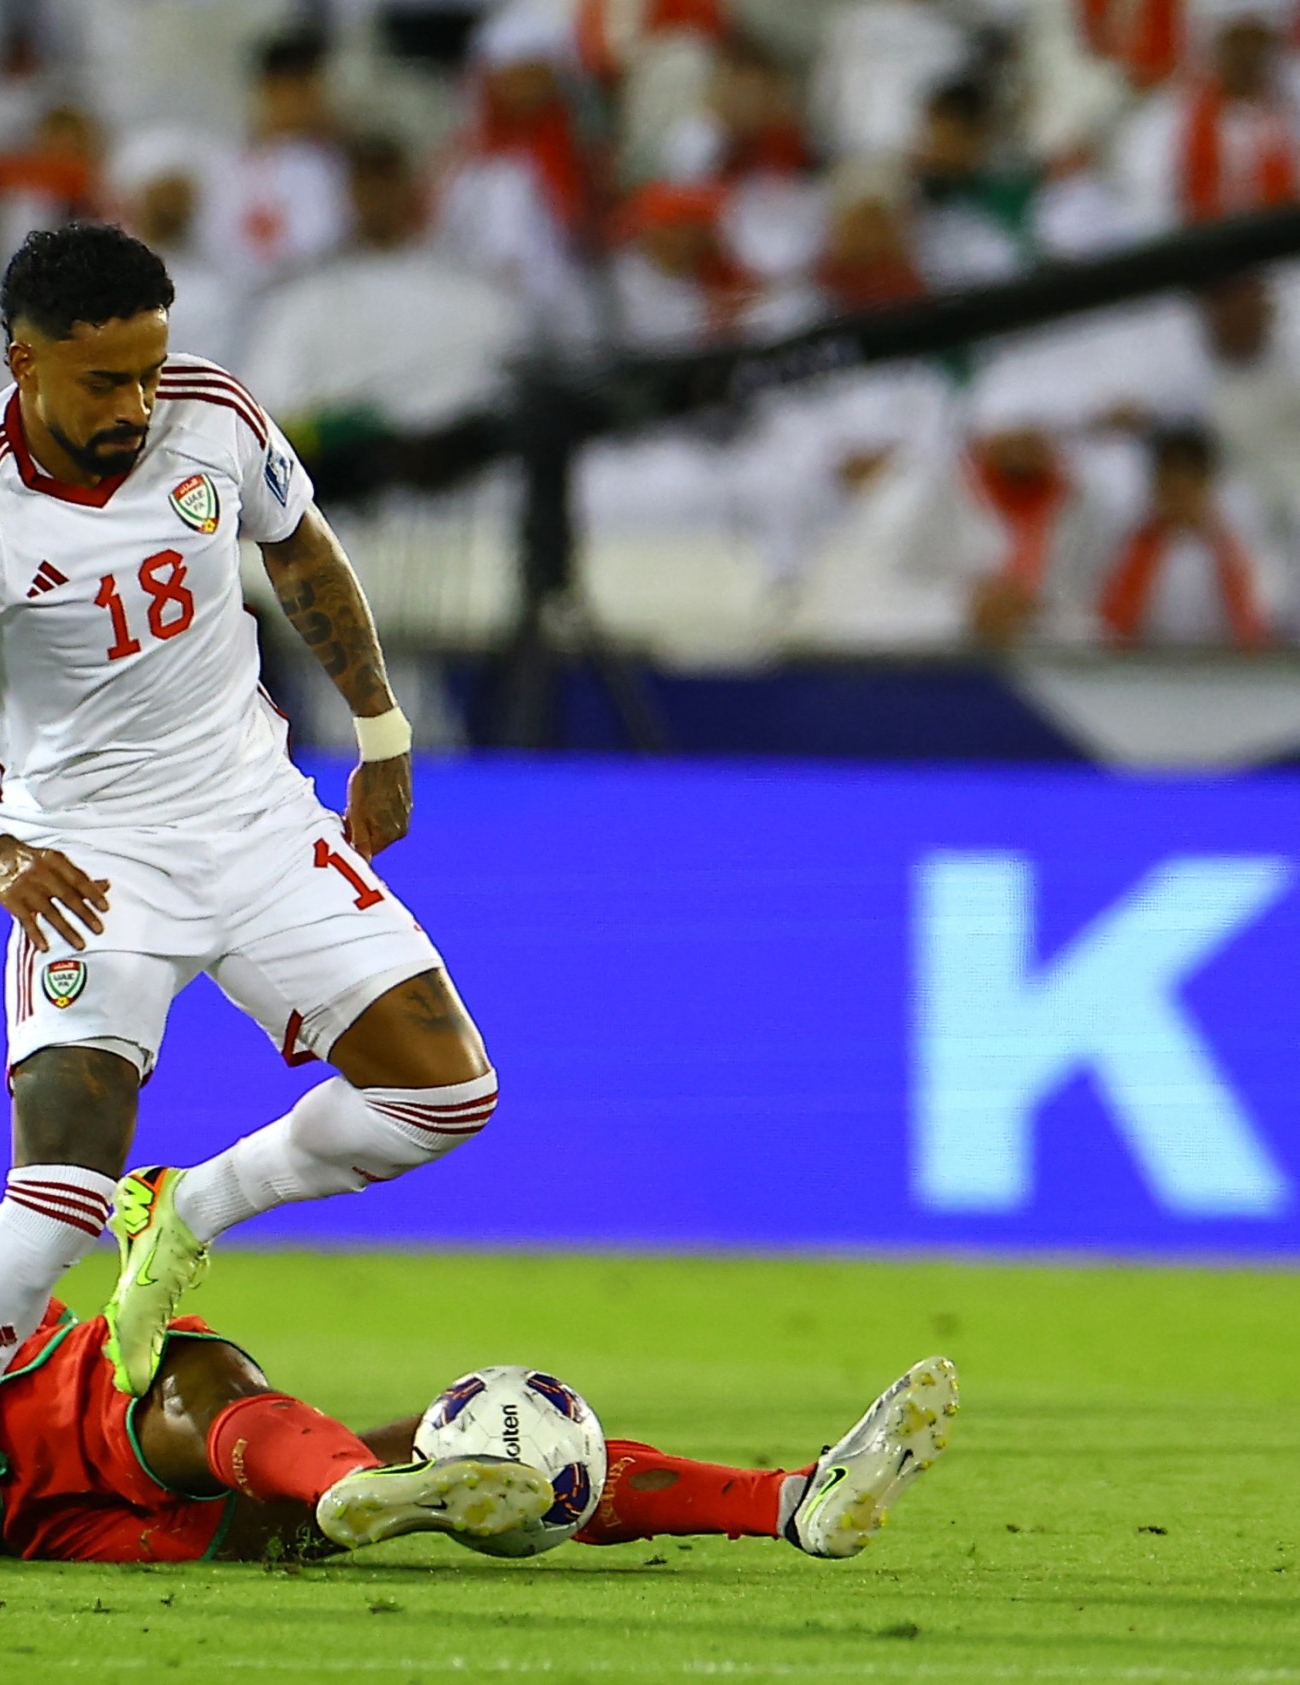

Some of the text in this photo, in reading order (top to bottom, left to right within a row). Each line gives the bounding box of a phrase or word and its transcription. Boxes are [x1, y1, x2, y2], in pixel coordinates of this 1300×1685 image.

[94, 549, 195, 660] 18
[914, 851, 1293, 1216] K
[501, 1404, 521, 1462] olten
